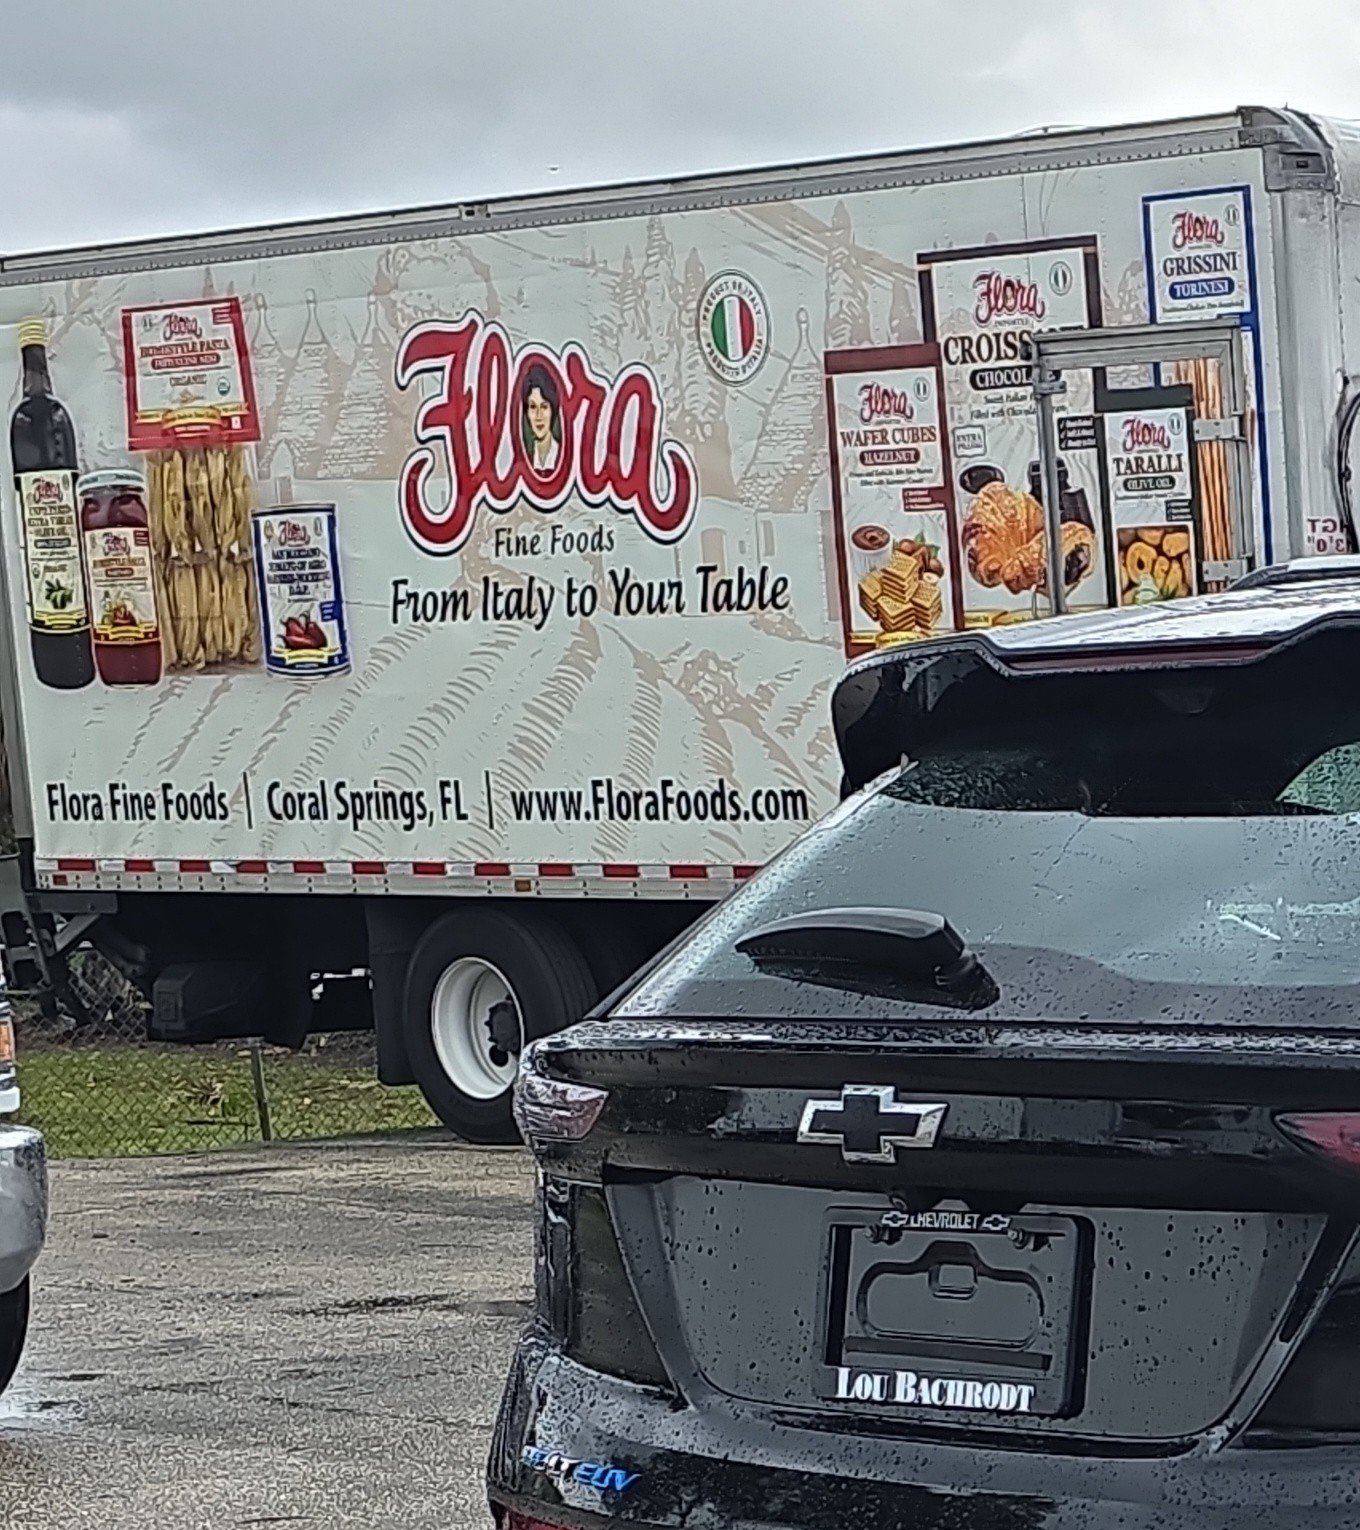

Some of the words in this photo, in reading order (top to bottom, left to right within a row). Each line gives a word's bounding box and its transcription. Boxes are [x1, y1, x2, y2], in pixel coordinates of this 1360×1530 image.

[1172, 211, 1225, 249] Flora
[1163, 251, 1238, 277] GRISSINI
[973, 271, 1045, 325] Flora
[1174, 280, 1229, 297] TORINESI
[976, 369, 1034, 388] CHOCOL
[858, 382, 914, 424] Flora
[401, 316, 692, 548] Flora
[840, 429, 889, 447] WAFER
[892, 426, 937, 444] CUBES
[1122, 417, 1171, 452] Flora
[1113, 453, 1184, 477] TARALLI
[495, 527, 541, 558] Fine
[550, 525, 615, 555] Foods
[391, 578, 472, 624] From
[482, 576, 556, 630] Italy
[566, 577, 597, 618] to
[609, 567, 686, 617] Your
[696, 565, 790, 616] Table
[46, 783, 104, 821] Flora
[108, 783, 156, 821] Fine
[161, 782, 229, 821] Foods
[266, 780, 330, 821] Coral
[334, 780, 435, 831] Springs,
[438, 779, 468, 821] FL
[511, 778, 810, 822] www.FloraFoods.com
[910, 1212, 980, 1229] CHEVROLET
[573, 1462, 642, 1491] EUV
